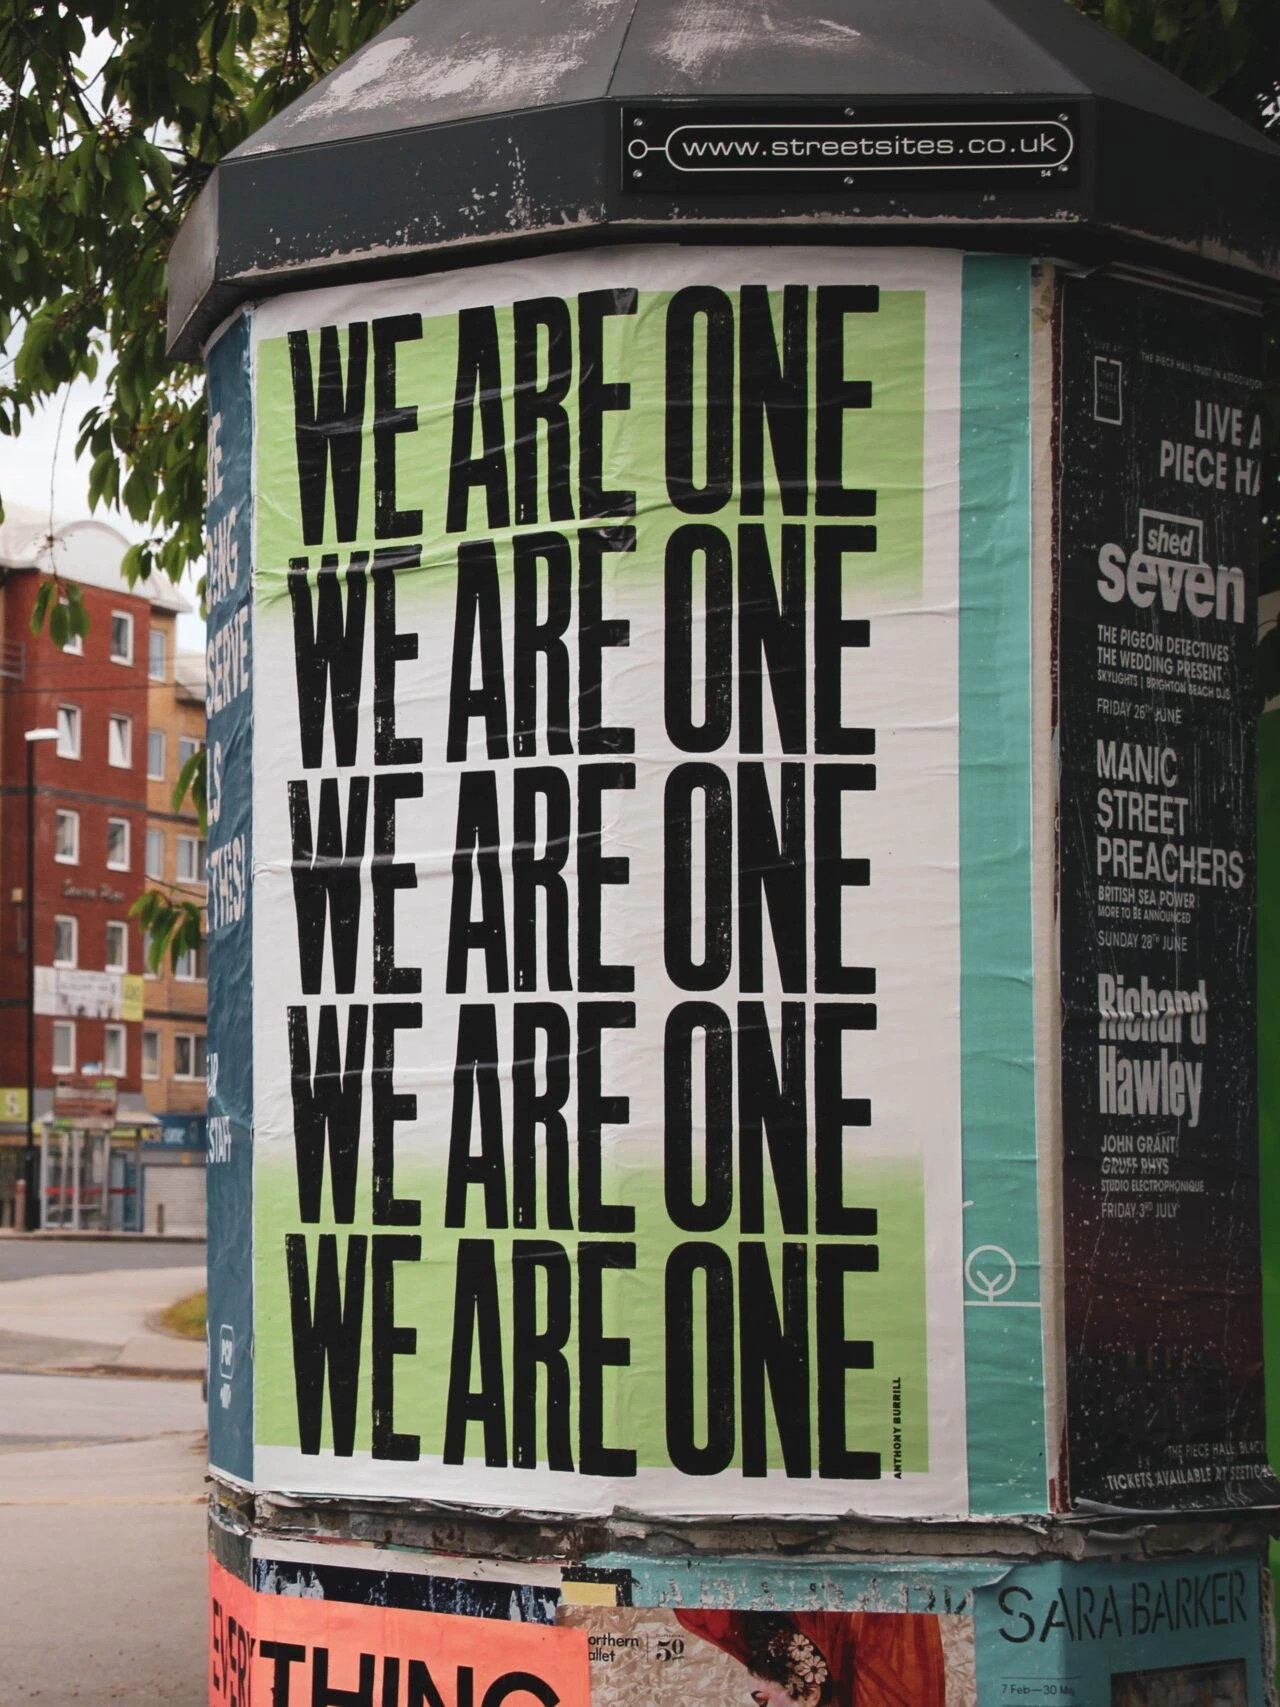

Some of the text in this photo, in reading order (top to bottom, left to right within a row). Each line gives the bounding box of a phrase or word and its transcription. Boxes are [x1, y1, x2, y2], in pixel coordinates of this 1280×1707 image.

[682, 132, 1057, 158] www.streetsites.co.uk
[288, 285, 879, 545] WE ARE ONE
[1195, 400, 1243, 446] LIVE
[1160, 439, 1227, 490] PIECE
[1147, 523, 1194, 557] shed
[288, 524, 877, 768] WE ARE ONE
[1097, 624, 1229, 662] THE PIGEON DETECTIVES
[1097, 646, 1222, 682] THE WEDDING PRESENT
[1097, 669, 1138, 687] SKYLIGHTS
[1146, 676, 1186, 694] BRIGHTON
[1188, 683, 1214, 699] BEACH
[1097, 698, 1132, 718] FRIDAY
[1154, 708, 1183, 725] JUNE
[1097, 739, 1178, 788] MANIC
[1097, 788, 1189, 836] STREET
[288, 762, 877, 994] WE ARE ONE
[1097, 836, 1244, 889] PREACHERS
[1098, 885, 1196, 909] BRITISH SEA POWER
[1098, 905, 1191, 924] MORE TO BE ANNOUNCED
[1097, 930, 1138, 948] SUNDAY
[1162, 935, 1188, 952] JUNE
[1098, 973, 1208, 1045] Richard
[1098, 1044, 1203, 1128] Hawley
[287, 1000, 878, 1235] WE ARE ONE
[1100, 1135, 1176, 1153] JOHN GRANT
[1101, 1156, 1169, 1175] GRUFF RHYS
[1101, 1179, 1205, 1193] STUDIO ELECTROPHONIQUE
[1101, 1202, 1136, 1218] FRIDAY
[1155, 1202, 1178, 1218] JULY
[286, 1234, 881, 1479] WE ARE ONE
[892, 1377, 902, 1480] ANTHONY BURRILL
[1186, 1443, 1209, 1457] PIECE
[1106, 1472, 1153, 1491] TICKETS
[1156, 1467, 1211, 1488] AVAILABLE
[1214, 1466, 1227, 1481] AT
[998, 1585, 1122, 1643] SARA
[1132, 1570, 1247, 1635] BARKER
[588, 1632, 639, 1647] orthern
[588, 1648, 616, 1662] allet
[1001, 1684, 1008, 1694] 7
